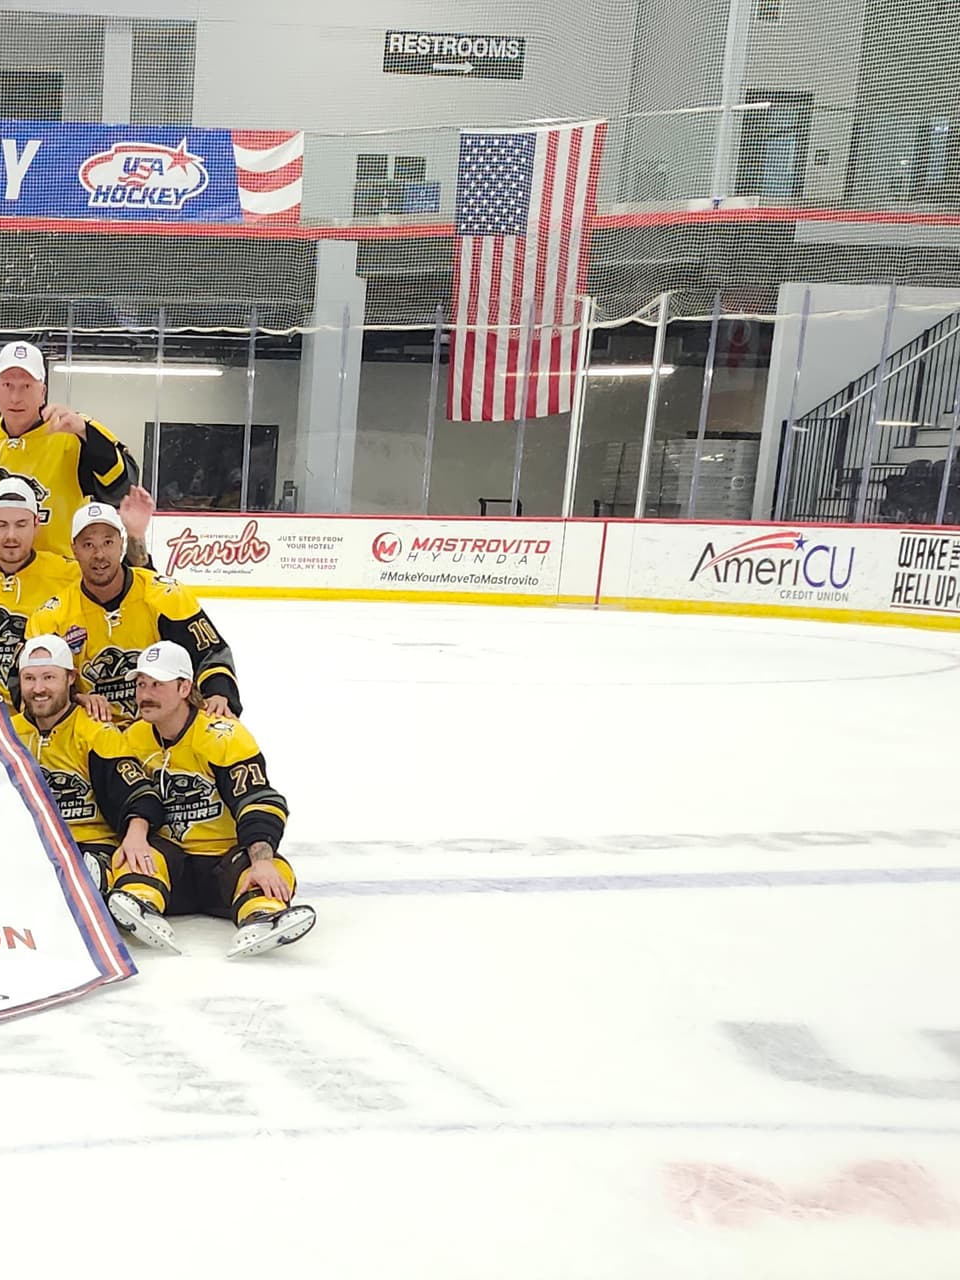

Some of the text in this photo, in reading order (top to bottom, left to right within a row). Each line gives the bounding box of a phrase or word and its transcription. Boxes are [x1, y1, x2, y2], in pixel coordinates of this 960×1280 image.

[389, 33, 520, 58] RESTROOMS
[119, 156, 165, 184] USA
[91, 183, 190, 206] HOCKEY
[406, 552, 547, 566] HYUNDAI
[410, 537, 551, 555] MASTROVITO
[898, 536, 950, 571] WAKE
[689, 541, 856, 590] AmeriCU
[379, 571, 539, 587] #MakeYourMoveToMastrovito
[891, 571, 930, 605] HELL
[934, 574, 957, 608] UP
[779, 589, 849, 602] CREDIT UNION
[187, 617, 221, 652] 10
[229, 763, 267, 797] 71
